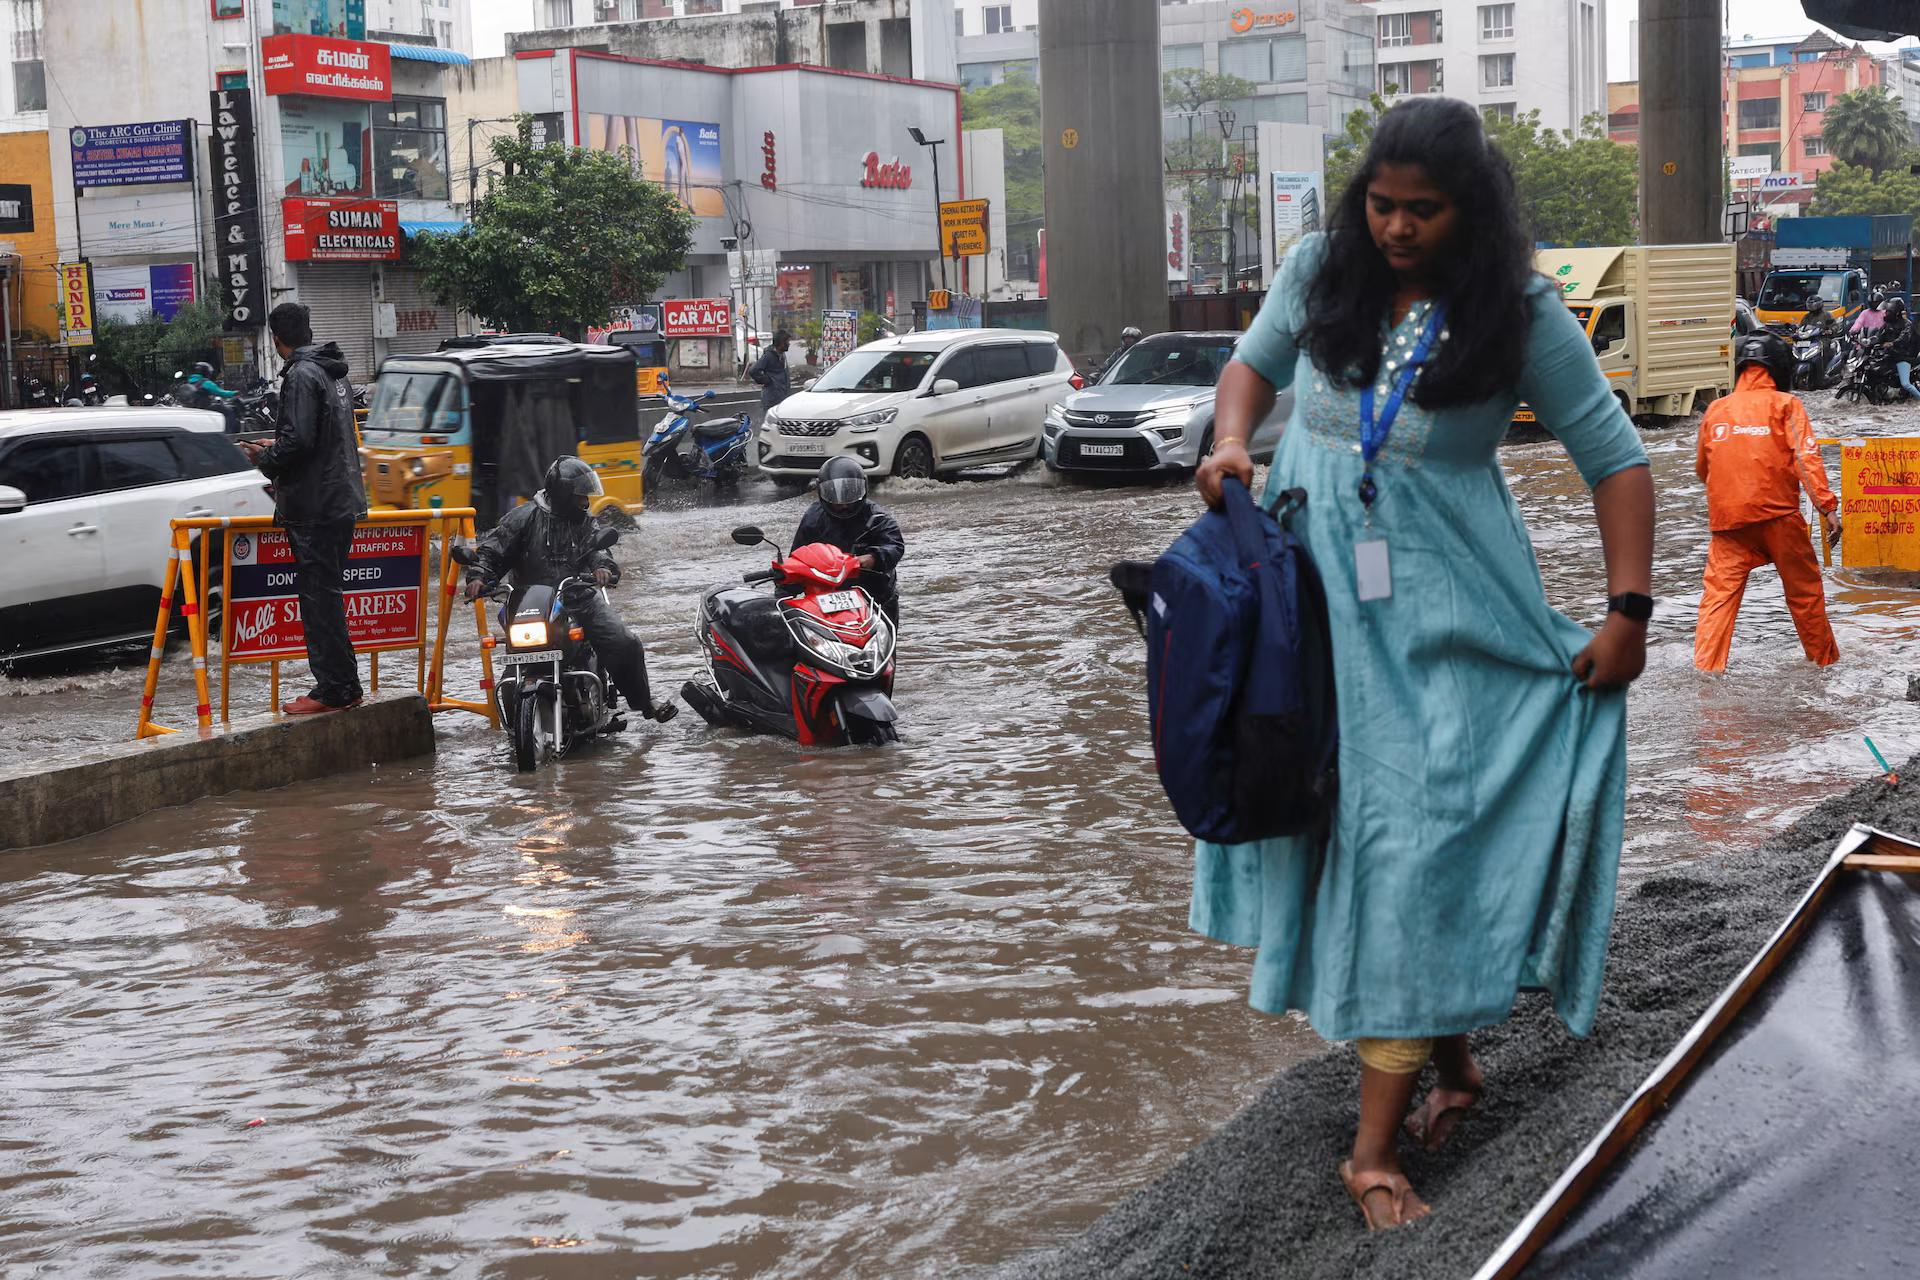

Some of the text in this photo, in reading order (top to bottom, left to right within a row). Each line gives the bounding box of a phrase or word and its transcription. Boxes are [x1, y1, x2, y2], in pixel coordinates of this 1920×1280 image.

[317, 47, 370, 70] சுமன்
[88, 122, 181, 139] The ARC Gut Clinic
[699, 127, 718, 140] Bata
[761, 130, 776, 192] Bata
[861, 151, 912, 189] Bata
[1765, 176, 1798, 187] max
[217, 91, 250, 322] Lawrence & Mayo
[329, 210, 383, 228] SUMAN
[319, 235, 395, 248] ELECTRICALS
[1168, 211, 1183, 271] Bata
[66, 267, 87, 329] HONDA
[114, 291, 143, 299] Securities
[684, 303, 709, 312] MALATI
[396, 310, 438, 332] MEX
[668, 311, 697, 326] CAR
[703, 310, 727, 325] A/C
[1732, 425, 1771, 436] Swiggy
[353, 527, 382, 540] RAFFIC
[383, 526, 413, 538] POLICE
[273, 547, 286, 558] J-9
[356, 543, 390, 553] TRAFFIC
[391, 541, 406, 551] P.S.
[267, 567, 382, 587] DON' SPEED
[346, 593, 407, 618] AREES
[232, 603, 277, 650] Nalli
[364, 619, 378, 627] Nagar
[258, 633, 278, 646] 100
